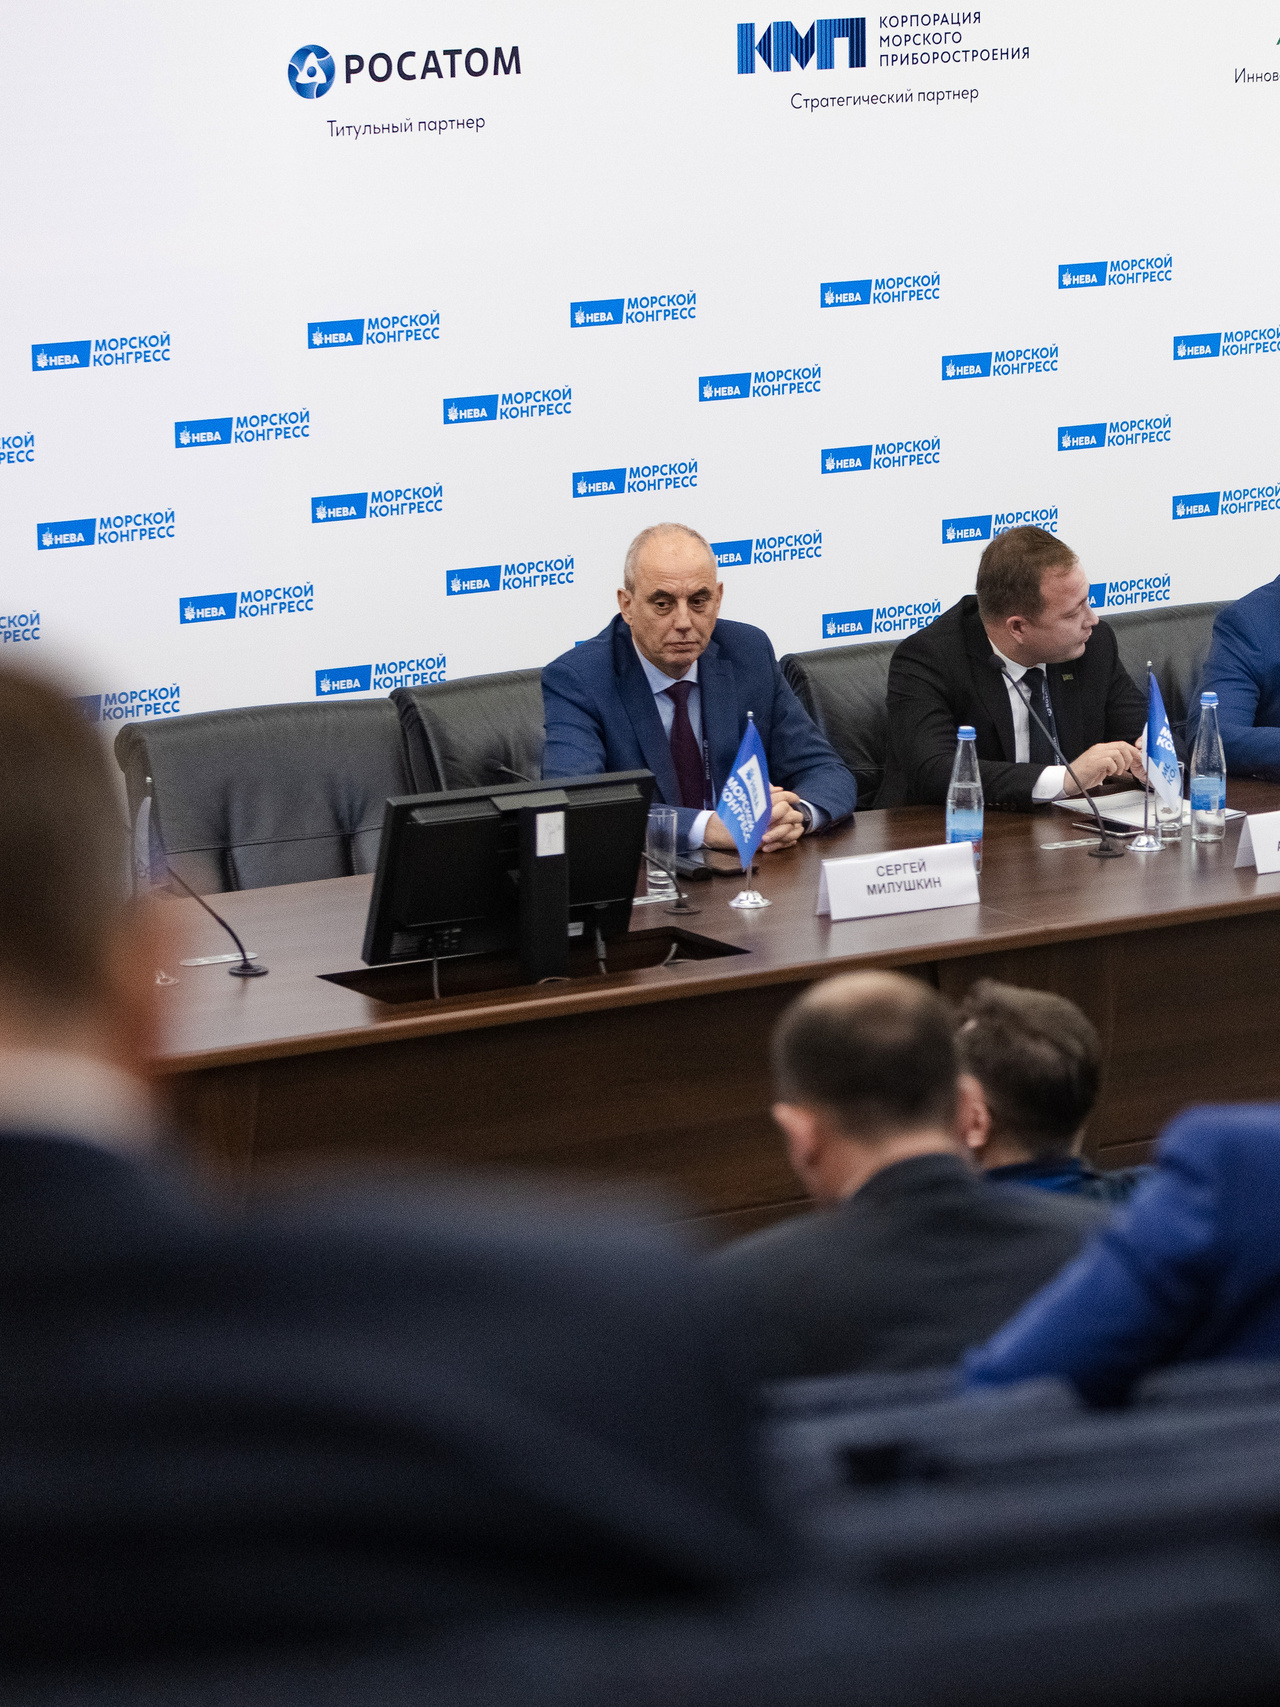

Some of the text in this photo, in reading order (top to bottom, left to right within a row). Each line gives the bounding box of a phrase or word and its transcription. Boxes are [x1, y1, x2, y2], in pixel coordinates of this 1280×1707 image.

[879, 11, 982, 28] КОРПОРАЦИЯ
[737, 17, 866, 74] КМП
[879, 31, 963, 48] МОРСКОГО
[345, 45, 521, 84] РОСАТОМ
[879, 46, 1031, 67] ПРИБОРОСТРОЕНИЯ
[790, 87, 979, 112] Стратегический партнер
[327, 116, 486, 140] Титульный партнер
[1110, 254, 1172, 272] МОРСКОЙ
[875, 272, 940, 290] МОРСКОЙ
[1073, 273, 1097, 285] НЕВА
[1108, 270, 1172, 285] КОНГРЕСС
[627, 290, 696, 310] МОРСКОЙ
[836, 292, 861, 304] НЕВА
[873, 288, 940, 304] КОНГРЕСС
[368, 310, 440, 330] МОРСКОЙ
[586, 311, 613, 323] НЕВА
[626, 307, 696, 324] КОНГРЕСС
[95, 331, 170, 352] МОРСКОЙ
[324, 332, 353, 344] НЕВА
[366, 327, 439, 344] КОНГРЕСС
[93, 348, 170, 367] КОНГРЕСС
[995, 344, 1058, 363] МОРСКОЙ
[1188, 344, 1211, 356] НЕВА
[49, 354, 79, 367] НЕВА
[993, 360, 1058, 376] КОНГРЕСС
[754, 364, 821, 384] МОРСКОЙ
[957, 364, 981, 376] НЕВА
[501, 385, 571, 406] МОРСКОЙ
[714, 385, 740, 397] НЕВА
[752, 380, 821, 397] КОНГРЕСС
[236, 408, 310, 429] МОРСКОЙ
[460, 407, 487, 420] НЕВА
[500, 402, 571, 420] КОНГРЕСС
[1109, 414, 1171, 433] МОРСКОЙ
[191, 431, 221, 444] НЕВА
[234, 425, 309, 443] КОНГРЕСС
[1072, 435, 1096, 447] НЕВА
[1108, 430, 1170, 447] КОНГРЕСС
[875, 436, 940, 456] МОРСКОЙ
[629, 458, 697, 479] МОРСКОЙ
[836, 457, 862, 470] НЕВА
[873, 452, 940, 469] КОНГРЕСС
[371, 483, 443, 503] МОРСКОЙ
[588, 481, 615, 493] НЕВА
[628, 475, 697, 493] КОНГРЕСС
[328, 506, 356, 518] НЕВА
[369, 499, 442, 518] КОНГРЕСС
[995, 505, 1058, 525] МОРСКОЙ
[1186, 504, 1210, 515] НЕВА
[100, 508, 175, 530] МОРСКОЙ
[55, 532, 84, 545] НЕВА
[98, 525, 175, 544] КОНГРЕСС
[755, 529, 822, 550] МОРСКОЙ
[957, 527, 981, 539] НЕВА
[754, 546, 822, 564] КОНГРЕСС
[504, 555, 574, 576] МОРСКОЙ
[463, 578, 490, 591] НЕВА
[503, 571, 574, 590] КОНГРЕСС
[1109, 573, 1171, 593] МОРСКОЙ
[240, 582, 313, 604] МОРСКОЙ
[1107, 589, 1170, 607] КОНГРЕСС
[196, 606, 225, 619] НЕВА
[239, 599, 313, 618] КОНГРЕСС
[876, 599, 941, 619] МОРСКОЙ
[838, 622, 863, 634] НЕВА
[375, 654, 446, 676] МОРСКОЙ
[332, 678, 360, 691] НЕВА
[373, 670, 446, 690] КОНГРЕСС
[104, 683, 180, 706] МОРСКОЙ
[103, 700, 180, 721] КОНГРЕСС
[876, 859, 927, 877] СЕРГЕЙ
[866, 877, 942, 896] МИЛУШКИН
